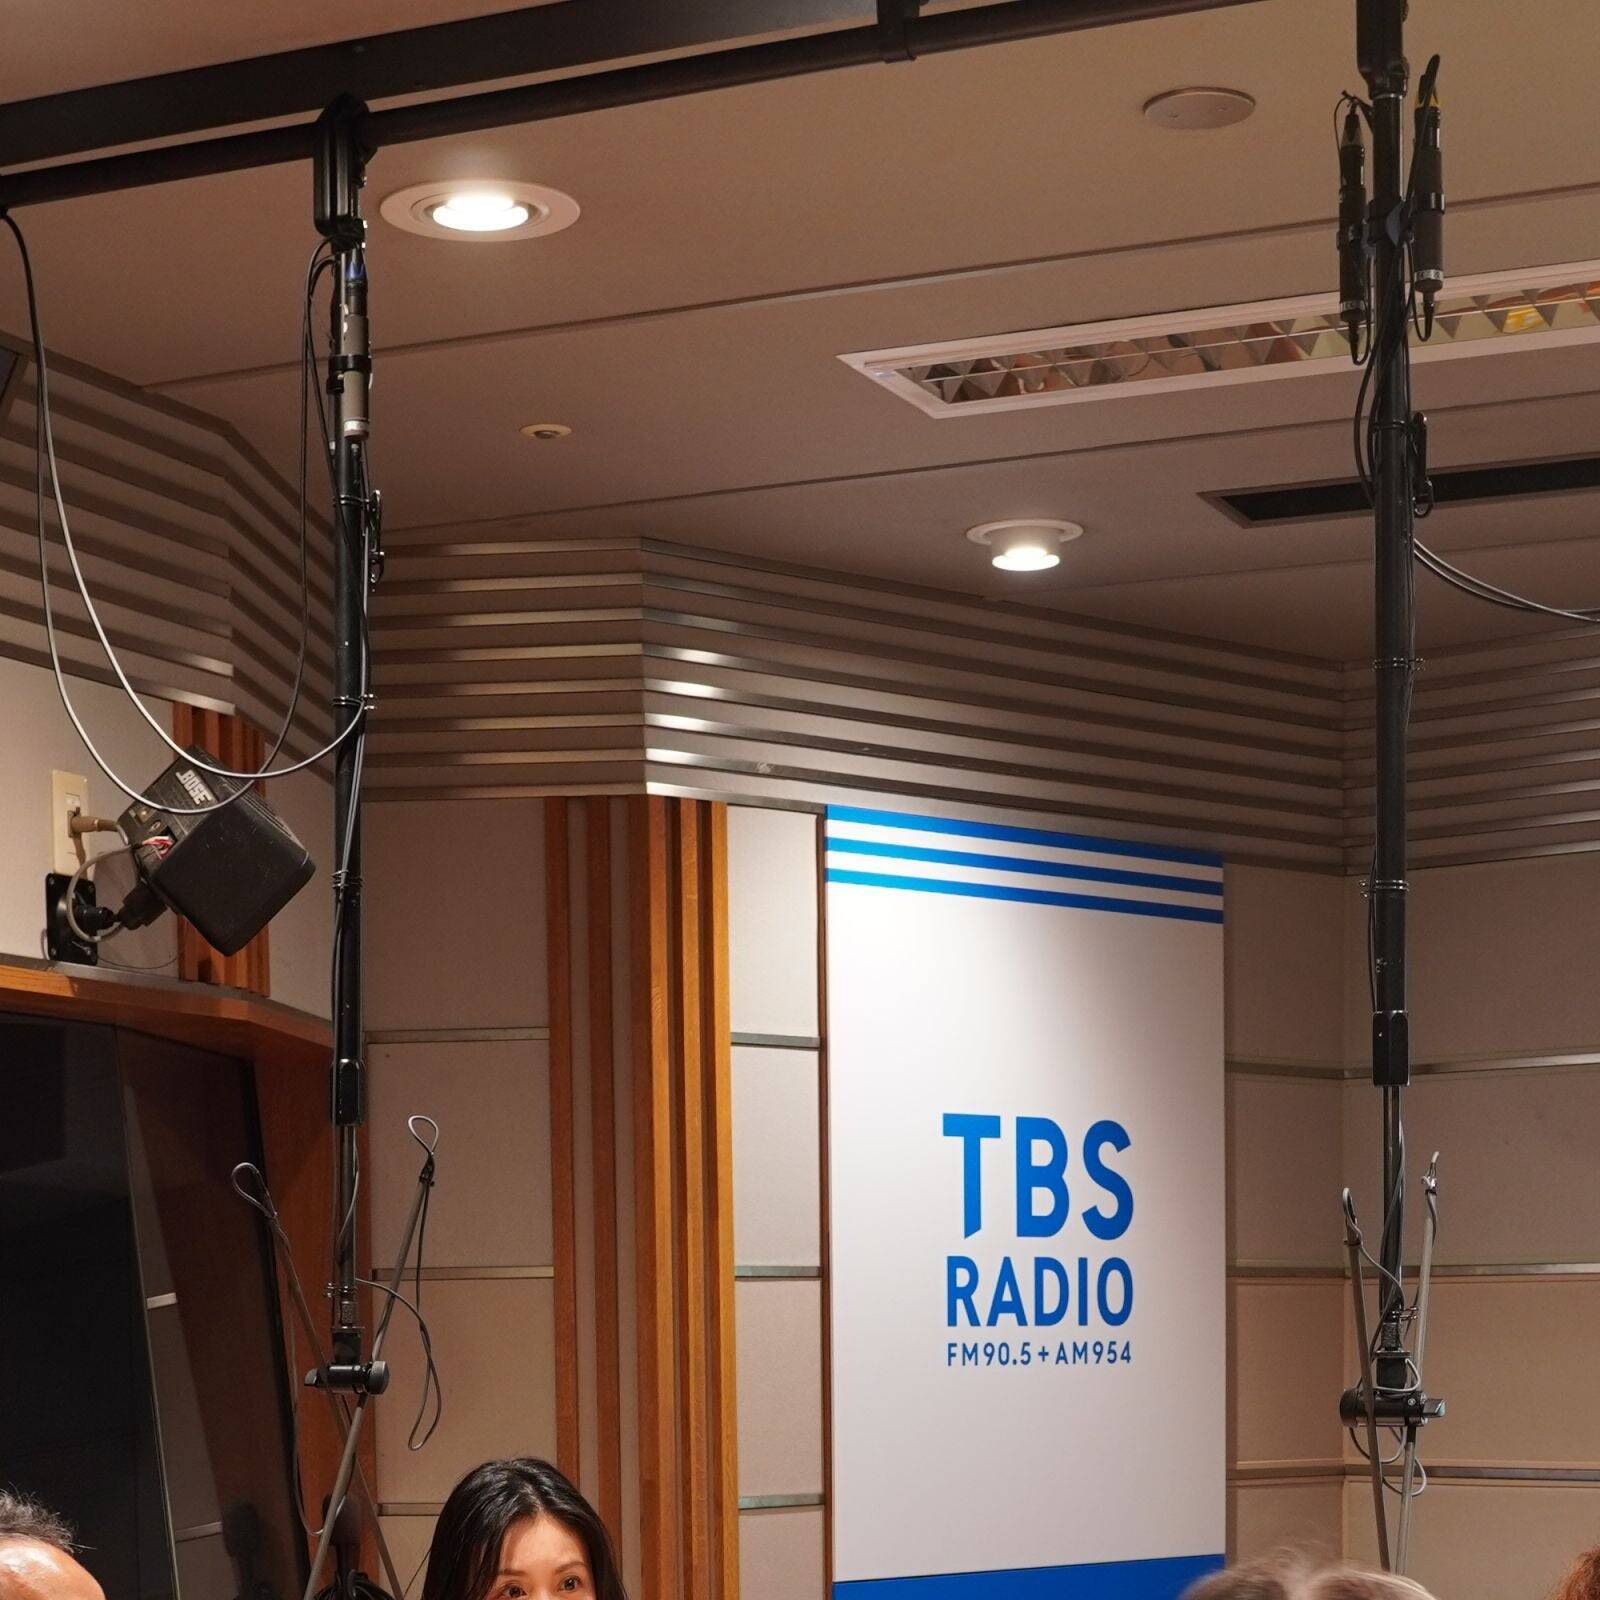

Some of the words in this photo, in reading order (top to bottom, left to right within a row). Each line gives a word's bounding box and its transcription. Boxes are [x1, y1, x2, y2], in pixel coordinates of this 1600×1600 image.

[176, 769, 212, 805] BOSE
[942, 1112, 1134, 1241] TBS
[946, 1255, 1134, 1327] RADIO
